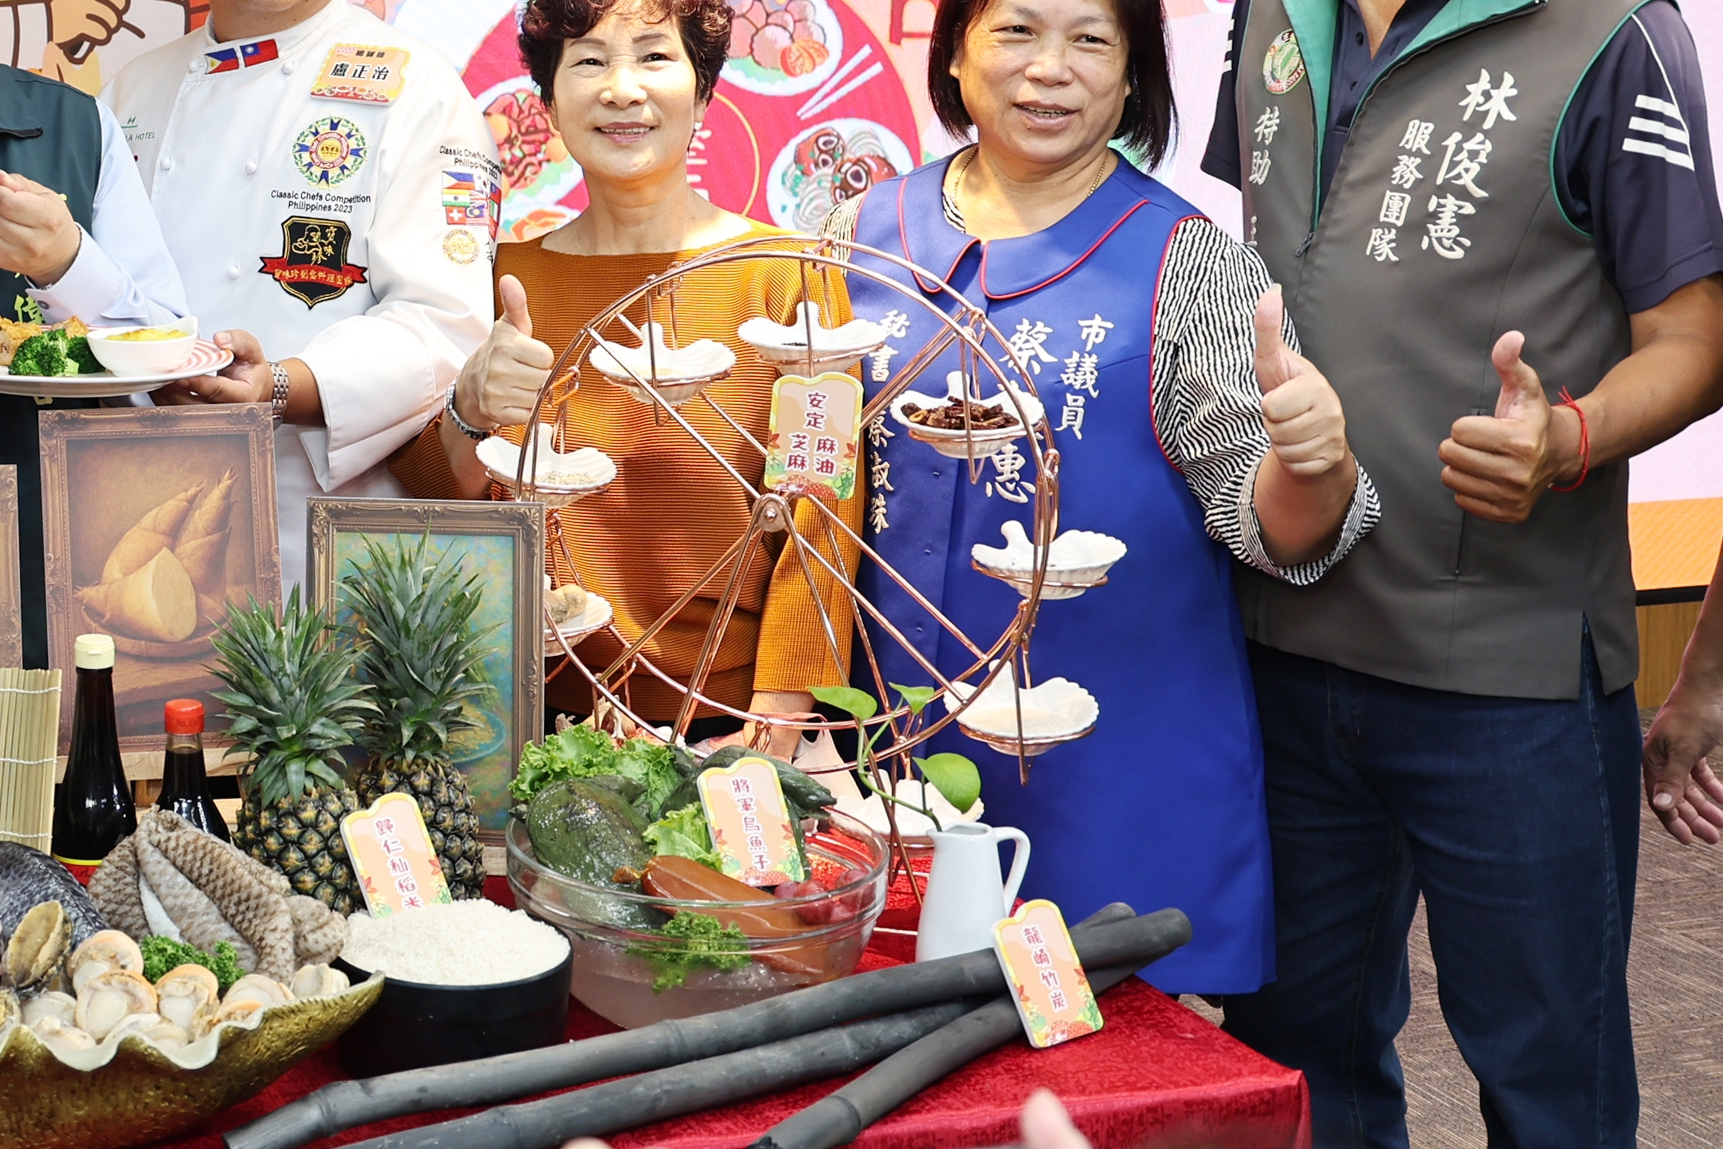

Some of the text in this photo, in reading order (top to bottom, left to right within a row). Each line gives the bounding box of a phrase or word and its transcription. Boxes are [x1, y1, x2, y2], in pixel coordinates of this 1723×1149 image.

[330, 63, 390, 81] 盧正治
[135, 132, 156, 141] HOTEL
[1249, 106, 1280, 185] 特助
[1421, 68, 1518, 260] 林俊憲
[271, 190, 371, 204] Classic Chefs Competition
[288, 201, 353, 214] Philippines 2023
[1366, 119, 1435, 262] 服務團隊
[805, 393, 827, 429] 安定
[986, 318, 1059, 504] 蔡惠
[1055, 313, 1115, 440] 市議員
[375, 818, 421, 909] 歸仁秈稻米
[731, 778, 769, 870] 將軍烏魚子
[1023, 926, 1066, 1011] 龍崎竹炭
